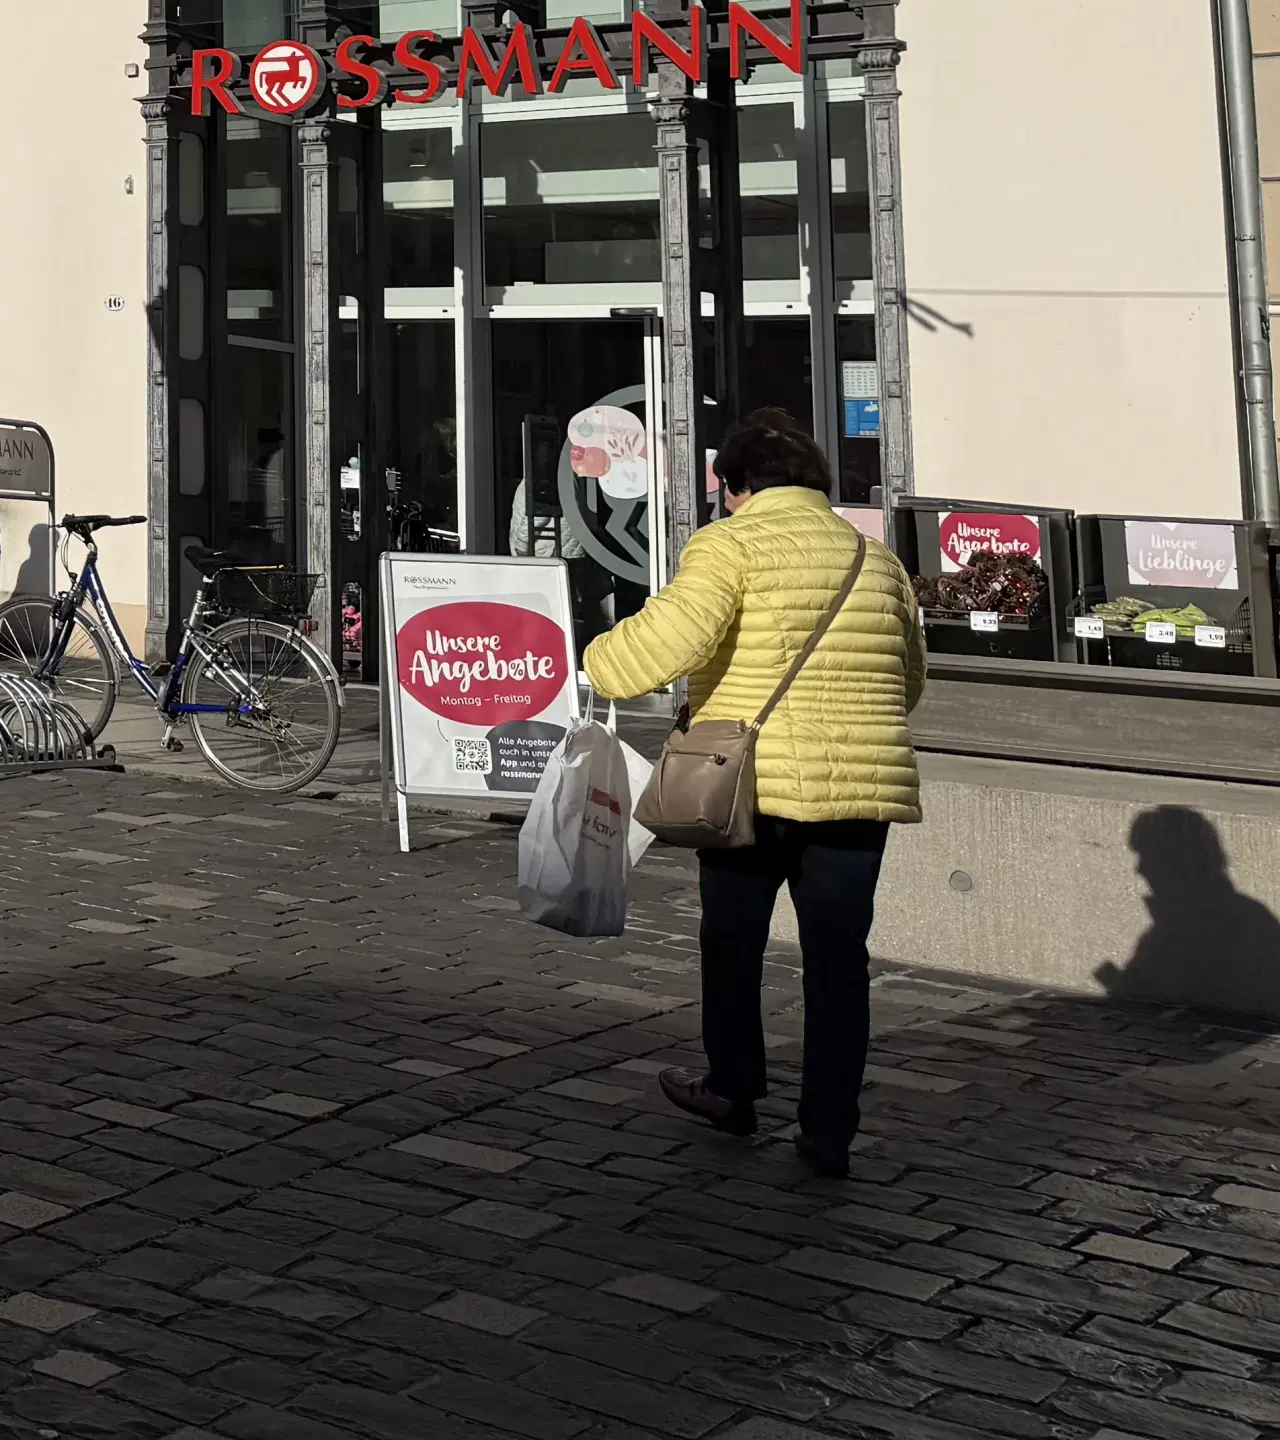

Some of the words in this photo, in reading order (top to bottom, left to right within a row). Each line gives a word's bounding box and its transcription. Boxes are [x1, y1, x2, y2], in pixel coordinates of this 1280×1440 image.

[957, 522, 1000, 538] Unsere
[1151, 534, 1198, 550] Unsere
[1140, 549, 1226, 576] Lieblinge
[404, 576, 457, 585] ROSSMANN
[426, 629, 501, 655] Unsere
[409, 650, 555, 693] Angebote
[440, 695, 481, 706] Montag
[494, 694, 531, 705] Freitag
[498, 737, 514, 746] Alle
[516, 738, 557, 748] Angebote
[499, 748, 519, 757] auch
[521, 749, 529, 757] in
[500, 759, 517, 769] App
[519, 759, 536, 767] und
